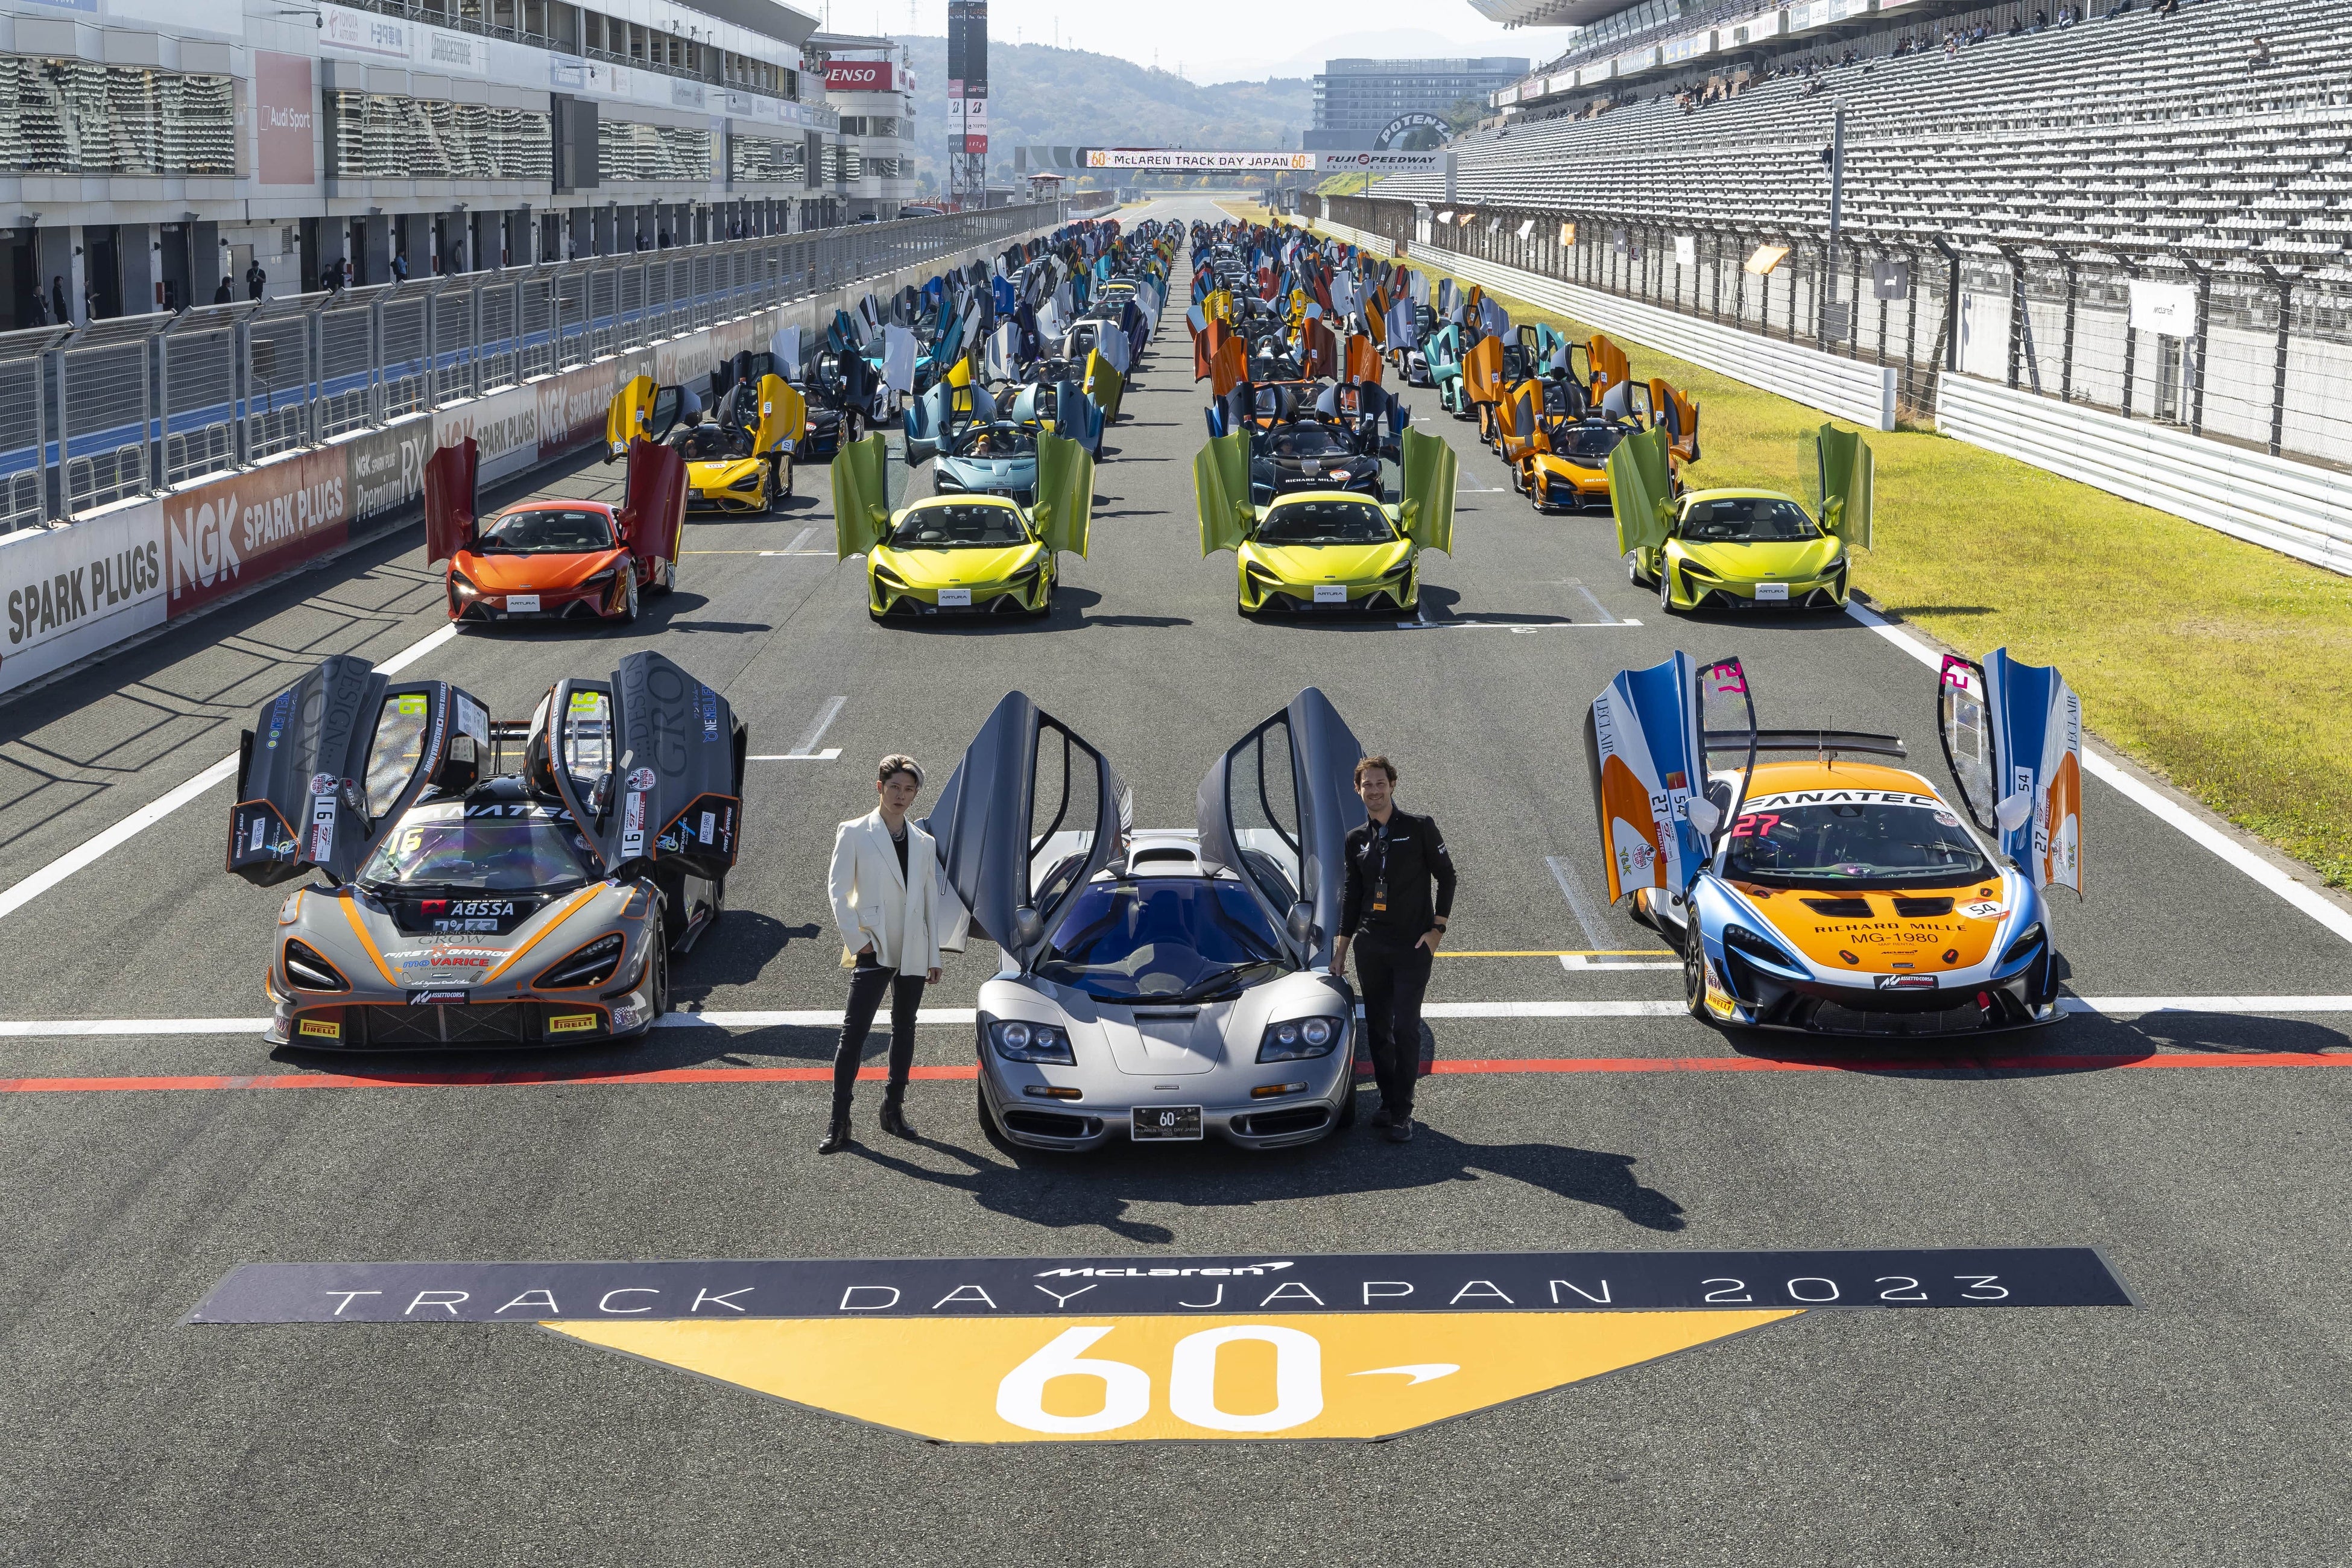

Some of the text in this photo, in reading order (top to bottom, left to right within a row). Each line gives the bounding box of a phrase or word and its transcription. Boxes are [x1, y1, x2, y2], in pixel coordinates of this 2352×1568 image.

[338, 11, 359, 28] TOYOTA
[340, 30, 358, 42] AUTO BODY
[431, 33, 471, 66] BRIDGESTONE
[271, 107, 311, 131] Audi Sport
[1381, 115, 1454, 144] POTENZA
[1091, 152, 1105, 166] 60
[1114, 156, 1288, 166] McLAREN TRACK DAY JAPAN
[1291, 154, 1306, 168] 60
[1358, 153, 1437, 165] SPEEDWAY
[658, 351, 676, 387] NGK
[678, 356, 694, 382] SPARK
[694, 349, 709, 378] PLUGS
[539, 381, 613, 448] NGK SPARK PLUGS
[476, 423, 506, 461] SPARK
[508, 410, 535, 449] PLUGS
[356, 453, 396, 479] NGK SPARK PLUG
[356, 434, 427, 523] Premium RX
[171, 476, 344, 600] NGK SPARK PLUGS
[8, 540, 160, 645] SPARK PLUGS
[1713, 662, 1746, 694] 27
[1941, 655, 1971, 689] 27
[323, 656, 368, 748] DESIGN
[399, 695, 427, 715] 16
[571, 692, 599, 712] 16
[625, 654, 650, 743] DESIGN
[646, 654, 687, 778] GRO
[1596, 697, 1614, 756] LECLAIR
[2067, 695, 2077, 753] LECLAIR
[423, 726, 444, 773] MASATAKA INOUE
[2018, 774, 2029, 792] 54
[346, 788, 356, 806] ABSSA
[1651, 794, 1669, 814] 27
[1674, 795, 1686, 814] 54
[1742, 792, 1935, 812] FANATEC
[317, 802, 334, 821] 16
[254, 820, 263, 847] MG-1980
[701, 814, 710, 841] MG-1980
[1732, 814, 1780, 838] 27
[388, 828, 424, 856] 16
[624, 833, 641, 852] 16
[1656, 829, 1665, 855] FANATEC
[2034, 831, 2047, 853] 27
[1619, 846, 1632, 876] Y&K
[2068, 844, 2076, 871] Y&K
[450, 903, 514, 916] ABSSA
[1969, 903, 1997, 915] 54
[418, 935, 487, 944] GROW
[1815, 923, 1967, 933] RICHARD MILLE
[1851, 932, 1939, 944] MG-1980
[384, 949, 515, 958] FIRST GARAGE
[1709, 991, 1732, 1011] PIRELLI
[302, 1022, 337, 1034] PIRELLI
[553, 1016, 593, 1031] PIRELLI
[1160, 1112, 1174, 1127] 60
[1033, 1264, 1269, 1278] McLaren
[325, 1275, 2010, 1316] TRACK DAY JAPAN 2023
[996, 1324, 1323, 1435] 60
